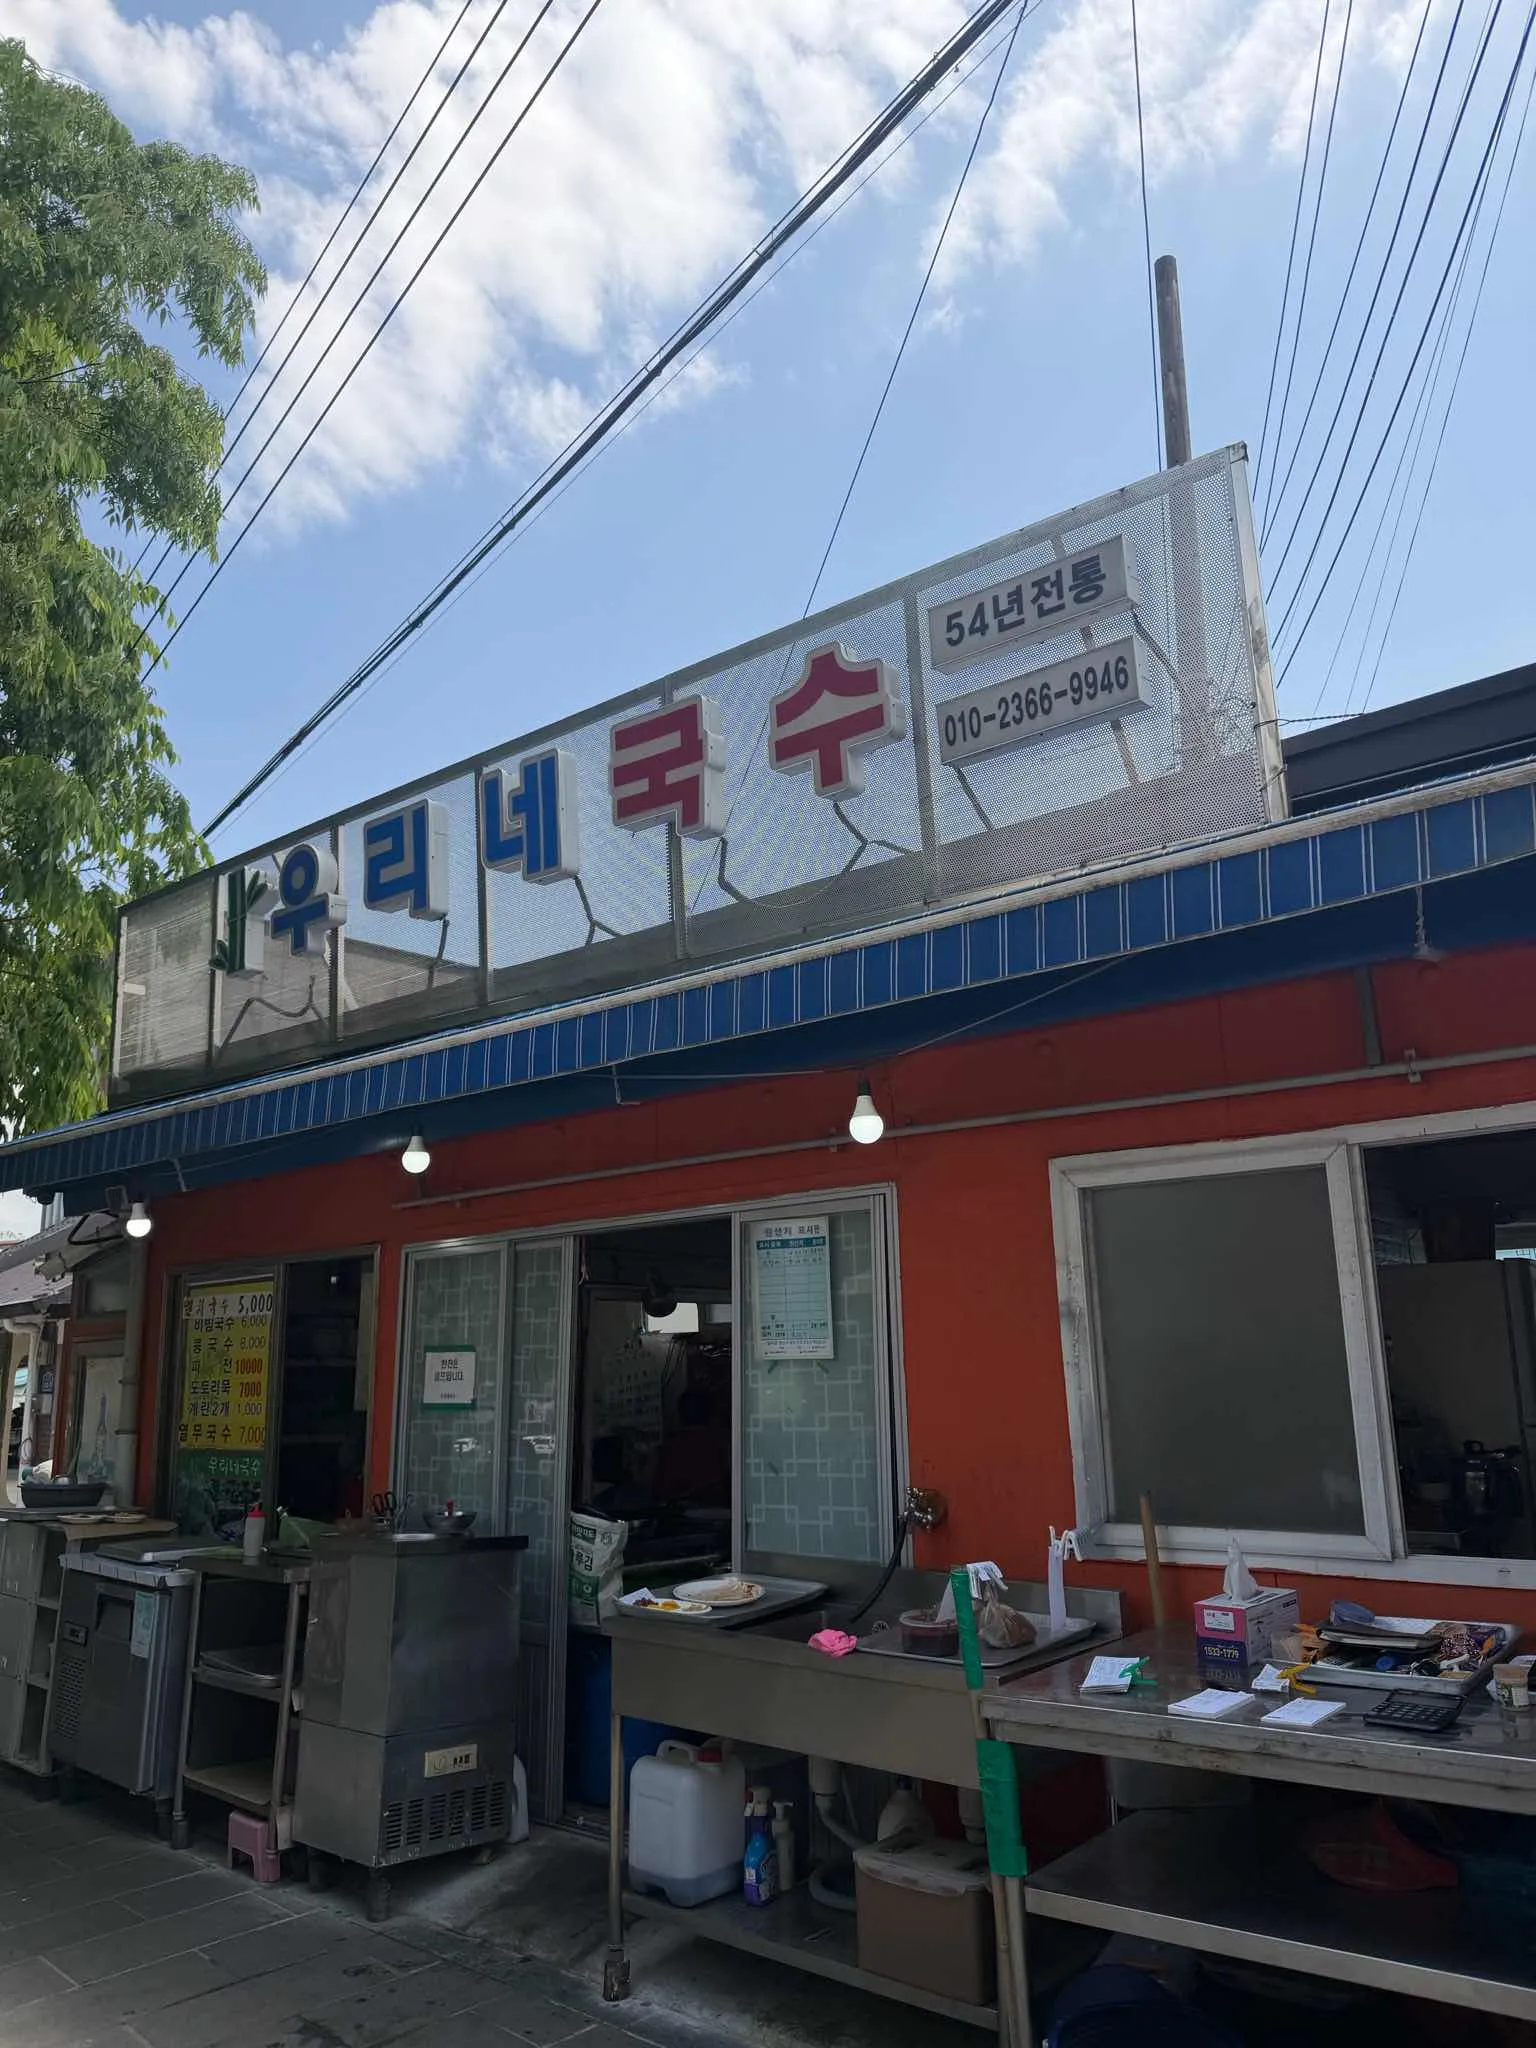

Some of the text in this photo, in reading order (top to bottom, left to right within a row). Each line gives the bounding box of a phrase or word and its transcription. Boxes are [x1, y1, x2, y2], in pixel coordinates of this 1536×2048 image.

[944, 655, 1129, 747] 010-2366-9946
[237, 1293, 273, 1314] 5,000
[194, 1316, 235, 1332] 비빔국수
[235, 1358, 263, 1375] 10000
[239, 1382, 262, 1398] 7000
